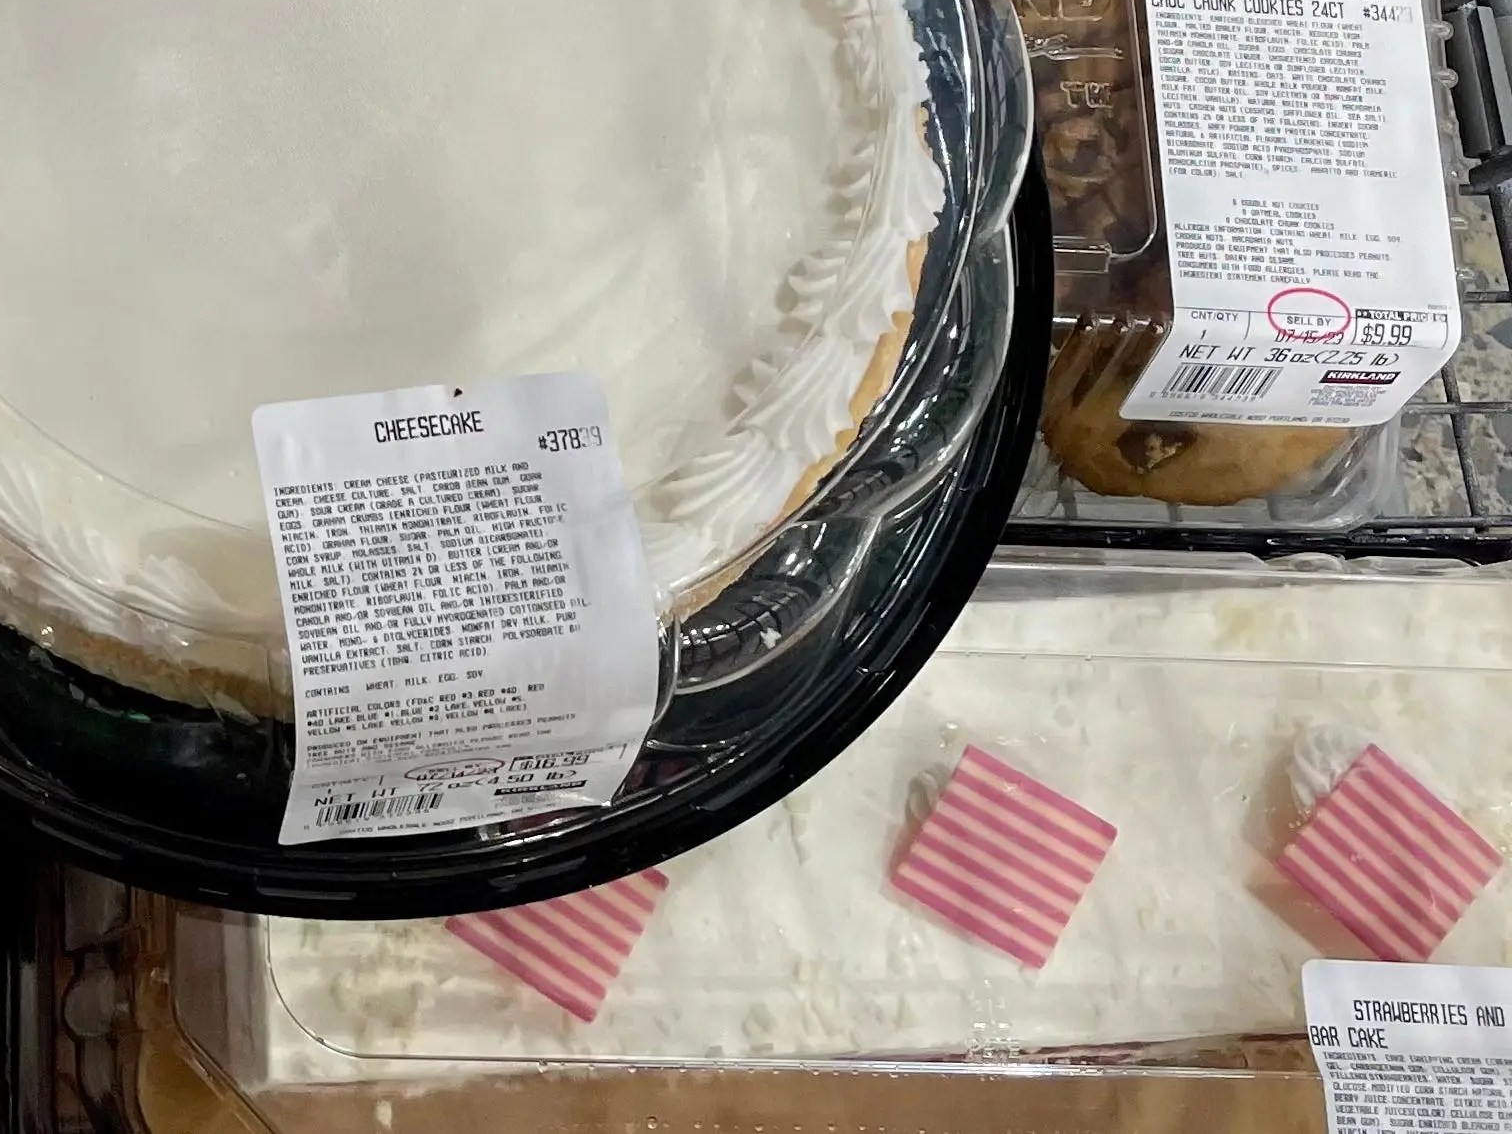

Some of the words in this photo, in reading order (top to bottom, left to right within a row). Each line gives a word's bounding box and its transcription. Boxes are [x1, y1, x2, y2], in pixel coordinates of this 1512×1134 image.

[1312, 1, 1345, 20] 24CT
[1191, 311, 1238, 322] CNT/QTY
[1286, 316, 1313, 325] SELL
[1369, 310, 1402, 321] TOTAL
[1274, 328, 1345, 346] 07/15/23
[1361, 322, 1412, 346] $9.99
[1179, 344, 1220, 359] NET
[1227, 346, 1255, 362] WT
[1369, 352, 1400, 367] lb)
[1326, 371, 1396, 381] KIRKLAND
[374, 410, 485, 444] CHEESECAKE
[344, 479, 371, 490] CREAM
[376, 475, 409, 487] CHEESE
[414, 466, 481, 483] (PASTEURIZED
[484, 464, 507, 475] MILK
[511, 461, 529, 471] AND
[313, 492, 347, 504] CHEESE
[465, 478, 488, 489] BEAN
[310, 506, 333, 517] SOUR
[337, 502, 365, 513] CREAM
[418, 493, 463, 505] CULTURED
[443, 503, 471, 514] FLOUR
[514, 494, 543, 506] FLOUR
[359, 522, 398, 534] THIAMIN
[437, 527, 460, 537] PALM
[285, 556, 309, 567] CORN
[440, 537, 474, 549] SODIUM
[288, 566, 316, 578] WHOLE
[321, 563, 345, 574] MILK
[348, 559, 377, 572] (WITH
[381, 555, 421, 567] VITAMIN
[447, 547, 482, 560] BUTTER
[361, 568, 407, 582] CONTAINS
[427, 564, 440, 575] OR
[444, 561, 468, 572] LESS
[472, 559, 483, 569] OF
[489, 556, 507, 567] THE
[291, 589, 337, 603] ENRICHED
[341, 585, 370, 597] FLOUR
[374, 580, 409, 593] (WHEAT
[432, 586, 462, 599] FOLIC
[504, 578, 528, 589] PALM
[295, 615, 330, 628] CANOLA
[373, 604, 414, 618] SOYBEAN
[418, 602, 435, 613] OIL
[479, 587, 564, 606] INTERESTERIFIED
[298, 627, 338, 639] SOYBEAN
[342, 624, 360, 635] OIL
[403, 615, 432, 626] FULLY
[437, 607, 505, 623] HYDROGENATED
[509, 599, 566, 615] COTTONSEED
[461, 620, 495, 633] NONFAT
[500, 618, 518, 629] DRY
[301, 651, 341, 664] VANILLA
[430, 639, 453, 650] CORN
[502, 625, 564, 640] POLYSORBATE
[303, 660, 376, 676] PRESERVATIVES
[419, 650, 454, 663] CITRIC
[466, 669, 483, 680] SOY
[306, 705, 361, 718] ARTIFICIAL
[367, 700, 400, 710] COLORS
[439, 693, 456, 702] RED
[478, 689, 495, 698] RED
[329, 716, 350, 725] LAKE
[356, 712, 377, 722] BLUE
[444, 702, 467, 712] LAKE
[472, 697, 507, 708] YELLOW
[307, 726, 341, 736] YELLOW
[362, 721, 384, 730] LAKE
[390, 716, 423, 726] YELLOW
[445, 709, 479, 720] YELLOW
[519, 754, 589, 771] $16.99
[314, 793, 356, 807] NET
[371, 787, 397, 799] WT
[1353, 999, 1468, 1026] STRAWBERRIES
[1476, 1006, 1505, 1027] AND
[1309, 1025, 1340, 1047] BAR
[1348, 1027, 1388, 1049] CAKE
